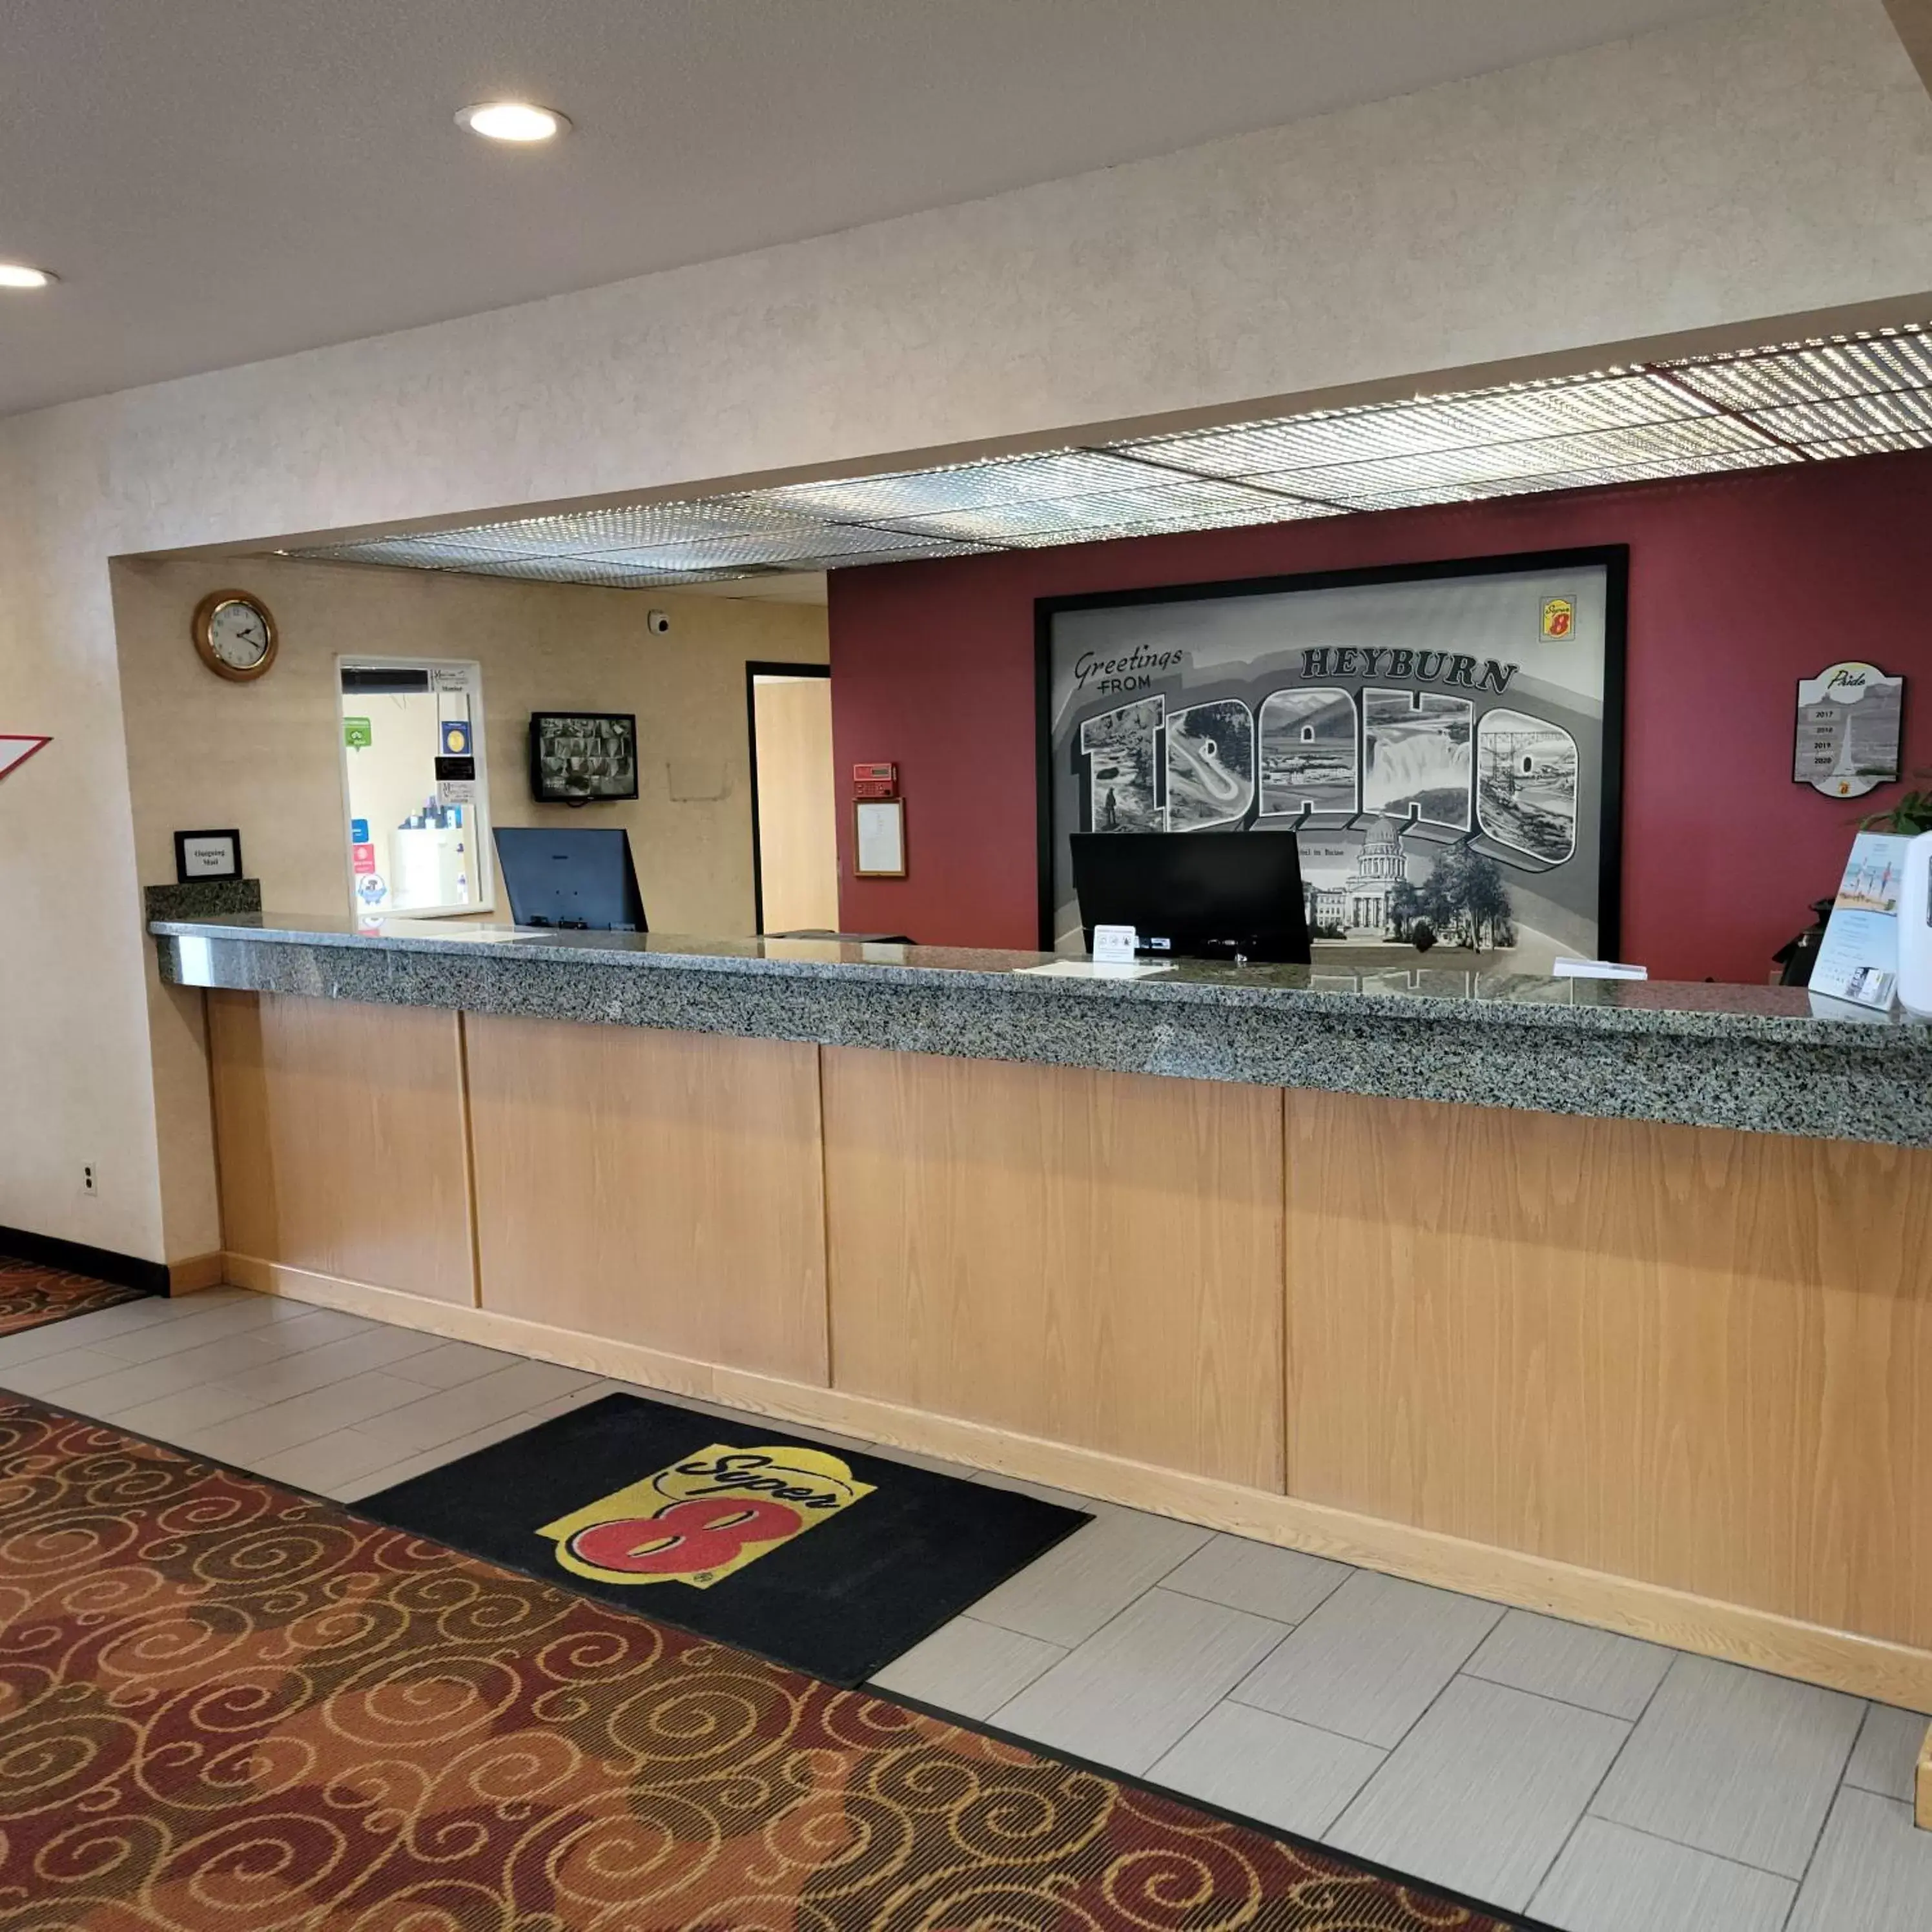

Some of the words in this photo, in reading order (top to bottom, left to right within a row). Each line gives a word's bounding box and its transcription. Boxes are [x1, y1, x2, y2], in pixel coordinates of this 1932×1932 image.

[1550, 612, 1570, 637] 8
[1074, 644, 1182, 690] Greetings
[1096, 674, 1151, 695] FROM
[1300, 647, 1518, 695] HEYBURN
[1827, 669, 1865, 690] Pride
[1078, 686, 1581, 865] IDAHO
[675, 1455, 840, 1508] Super
[566, 1496, 803, 1574] 8
